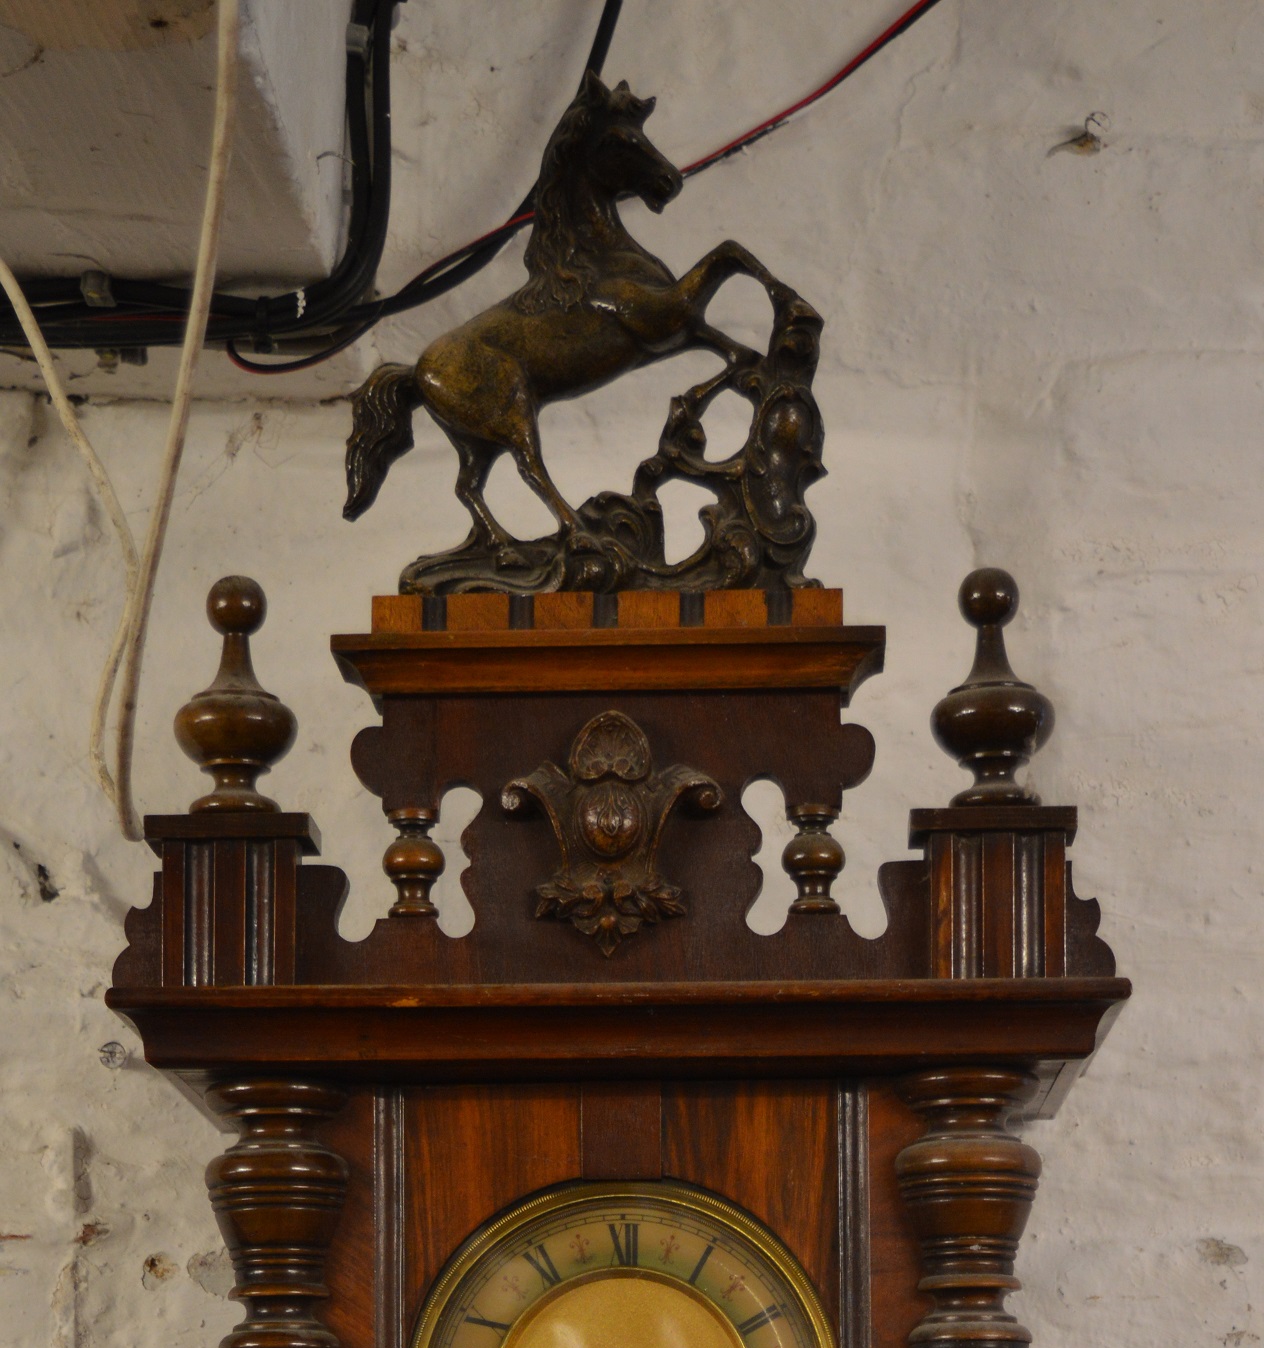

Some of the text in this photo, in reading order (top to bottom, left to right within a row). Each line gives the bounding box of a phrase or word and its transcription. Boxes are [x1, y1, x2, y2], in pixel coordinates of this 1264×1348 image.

[609, 1223, 638, 1265] XII
[523, 1245, 561, 1285] XI
[689, 1245, 713, 1284] I
[465, 1306, 508, 1338] X
[739, 1306, 781, 1335] II
